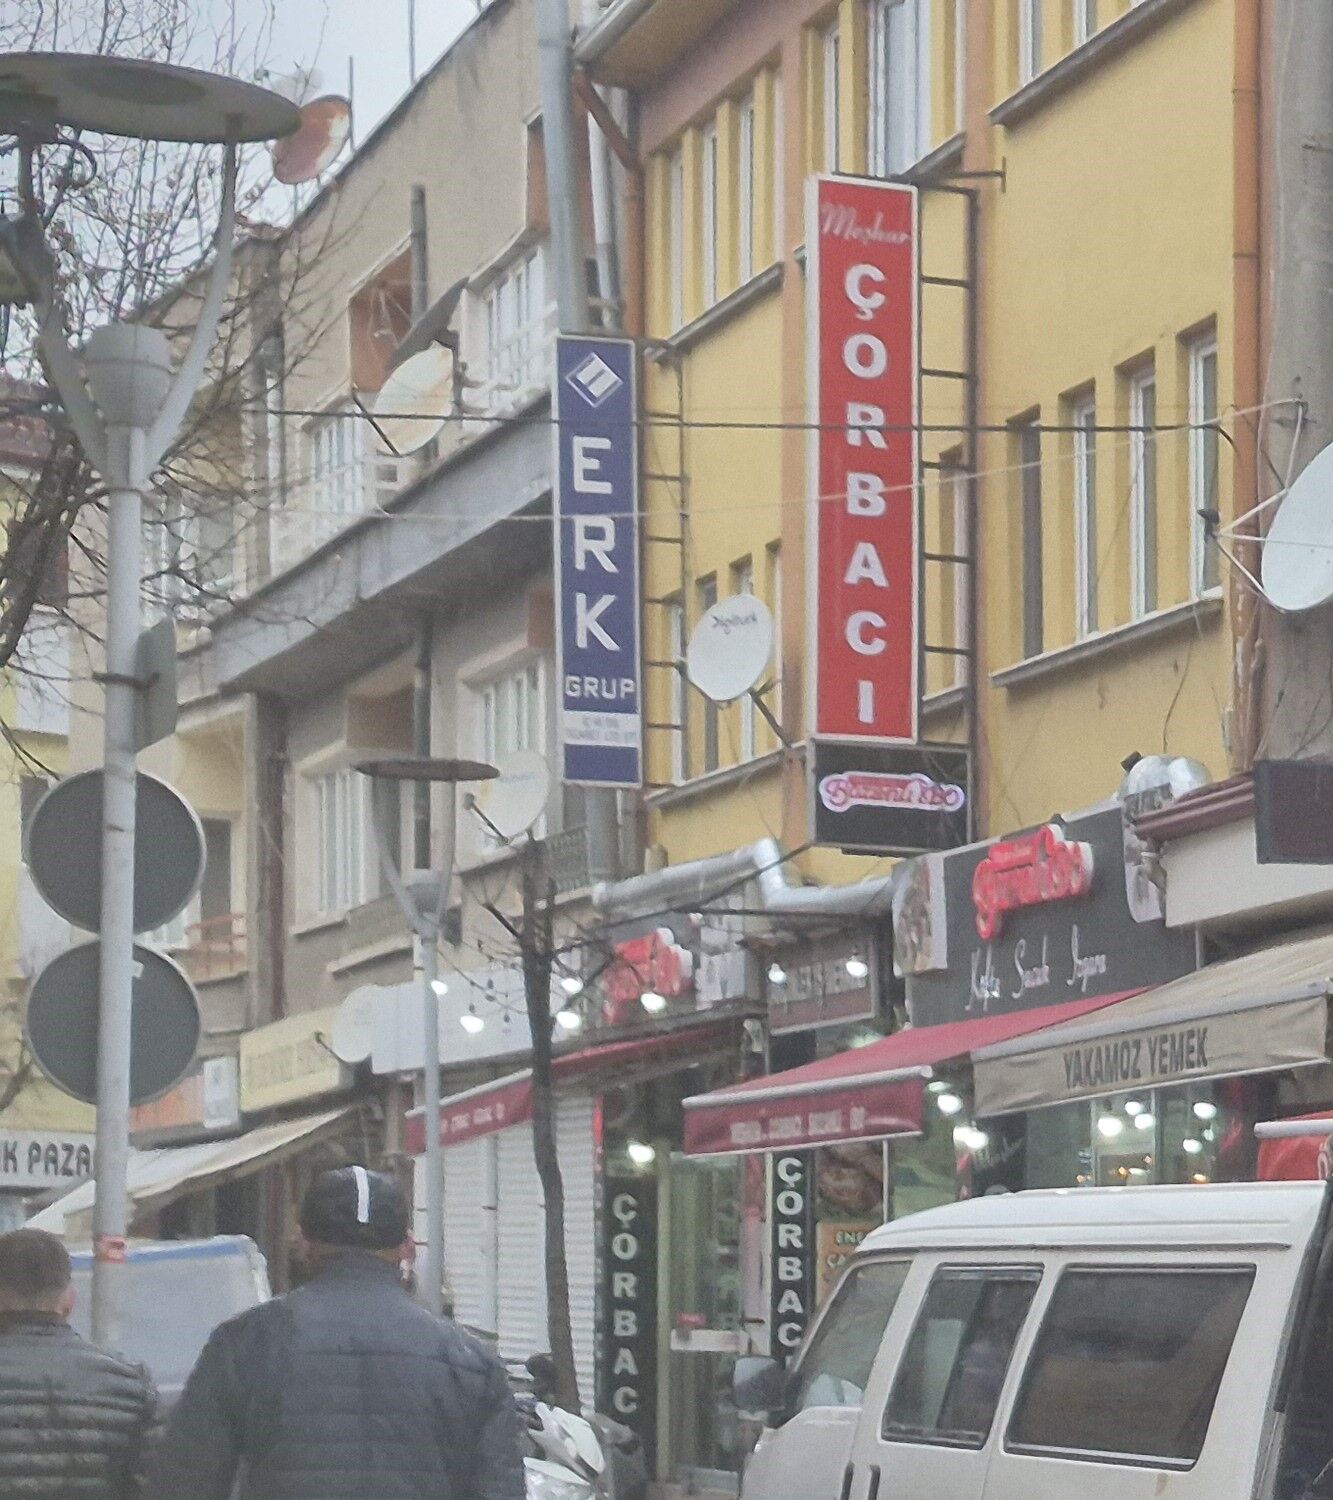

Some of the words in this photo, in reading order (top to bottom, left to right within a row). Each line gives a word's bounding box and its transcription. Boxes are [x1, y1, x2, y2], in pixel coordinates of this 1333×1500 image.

[572, 436, 620, 652] ERK
[843, 263, 889, 725] ÇORBACI
[565, 675, 635, 699] GRUP
[1064, 1034, 1141, 1090] YAKAMOZ
[1148, 1027, 1209, 1074] YEMEK
[612, 1193, 639, 1413] ÇORBAC
[776, 1157, 803, 1349] ÇORBAC
